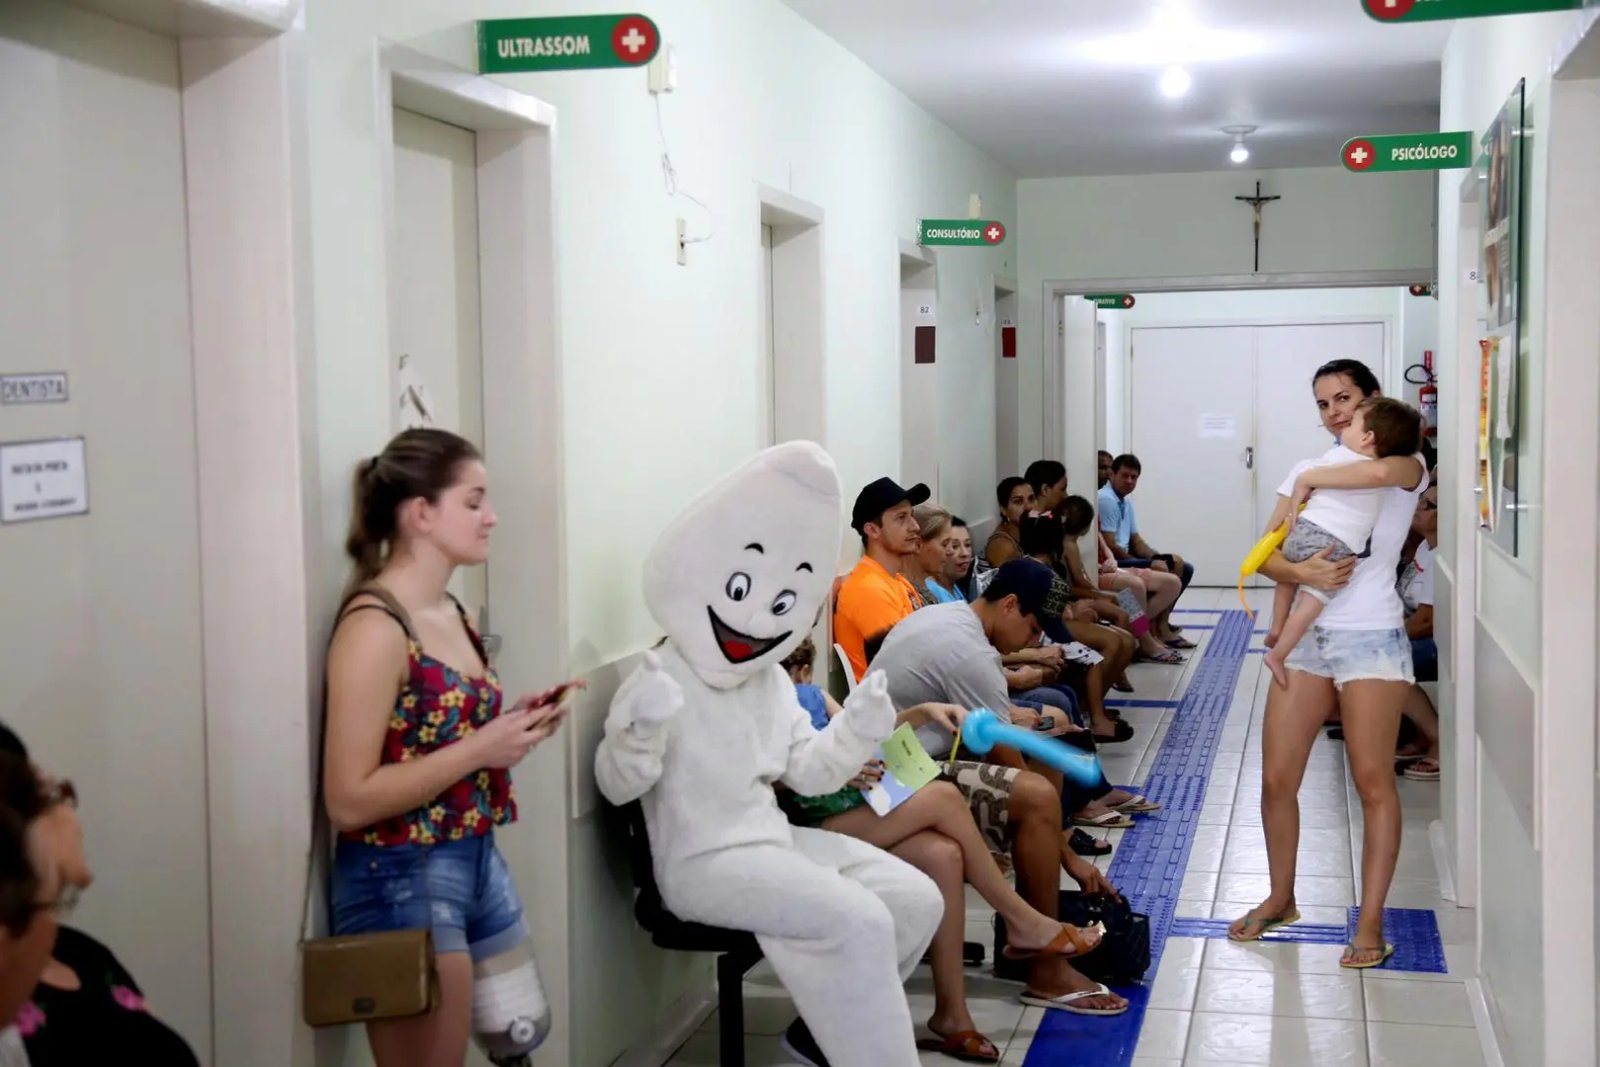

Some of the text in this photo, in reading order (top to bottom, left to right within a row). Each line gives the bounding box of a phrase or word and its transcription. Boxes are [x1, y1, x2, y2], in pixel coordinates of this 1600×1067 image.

[497, 35, 591, 58] ULTRASSOM
[1391, 143, 1458, 161] PSICÓLOGO
[926, 226, 981, 239] CONSULTÓRIO
